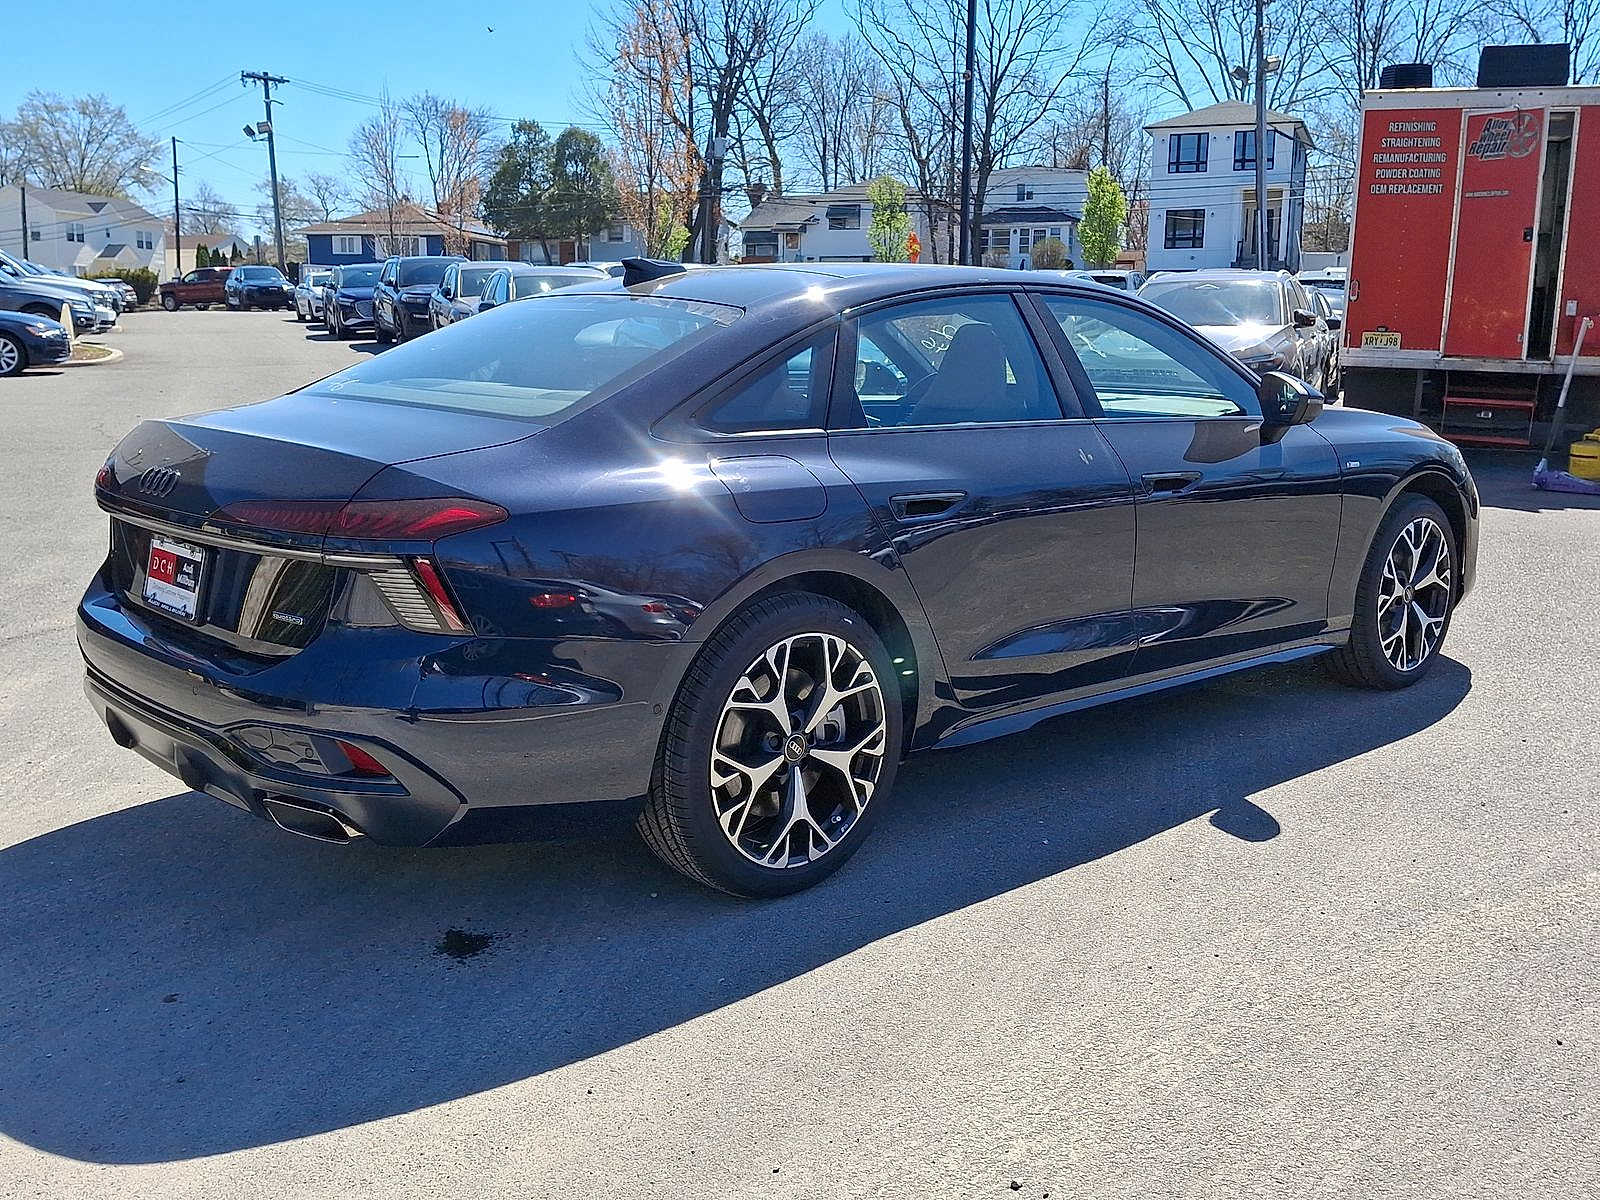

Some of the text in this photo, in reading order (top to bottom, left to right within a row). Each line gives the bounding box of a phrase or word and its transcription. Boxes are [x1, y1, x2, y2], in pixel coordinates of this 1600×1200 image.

[1388, 122, 1437, 132] REFINISHING
[1483, 118, 1510, 132] Alloy
[1381, 137, 1442, 148] STRAIGHTENING
[1468, 142, 1508, 159] Repair
[1373, 153, 1447, 163] REMANUFACTURING
[1375, 168, 1441, 179] POWDER COATING
[1370, 183, 1444, 194] OEM REPLACEMENT
[152, 556, 174, 576] DCH
